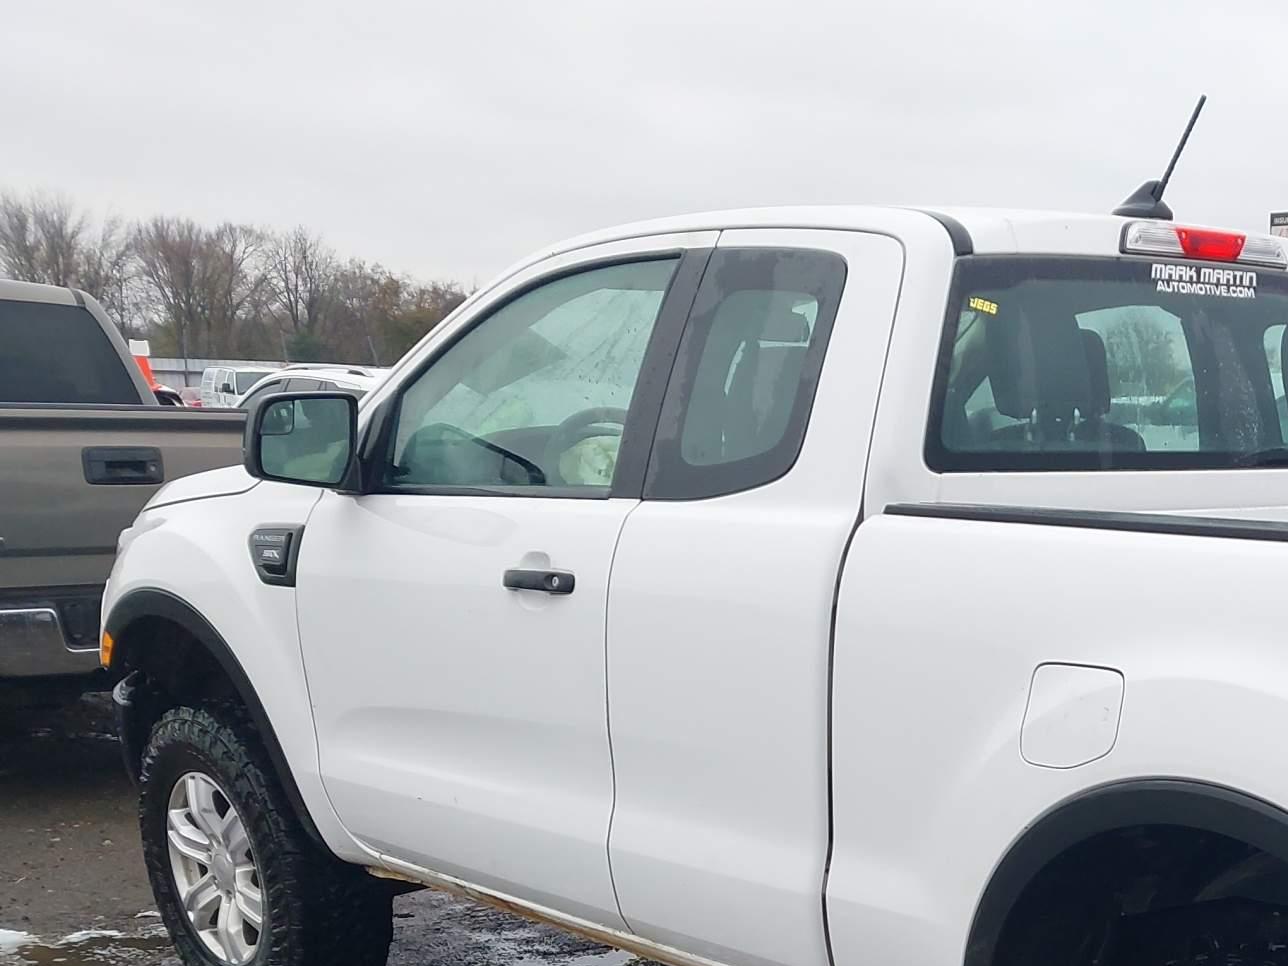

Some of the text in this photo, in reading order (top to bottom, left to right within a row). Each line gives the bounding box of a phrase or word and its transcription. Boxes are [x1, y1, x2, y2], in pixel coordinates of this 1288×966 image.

[1151, 264, 1257, 287] MARK MARTIN
[1156, 281, 1256, 298] AUTOMOTIVE.COM
